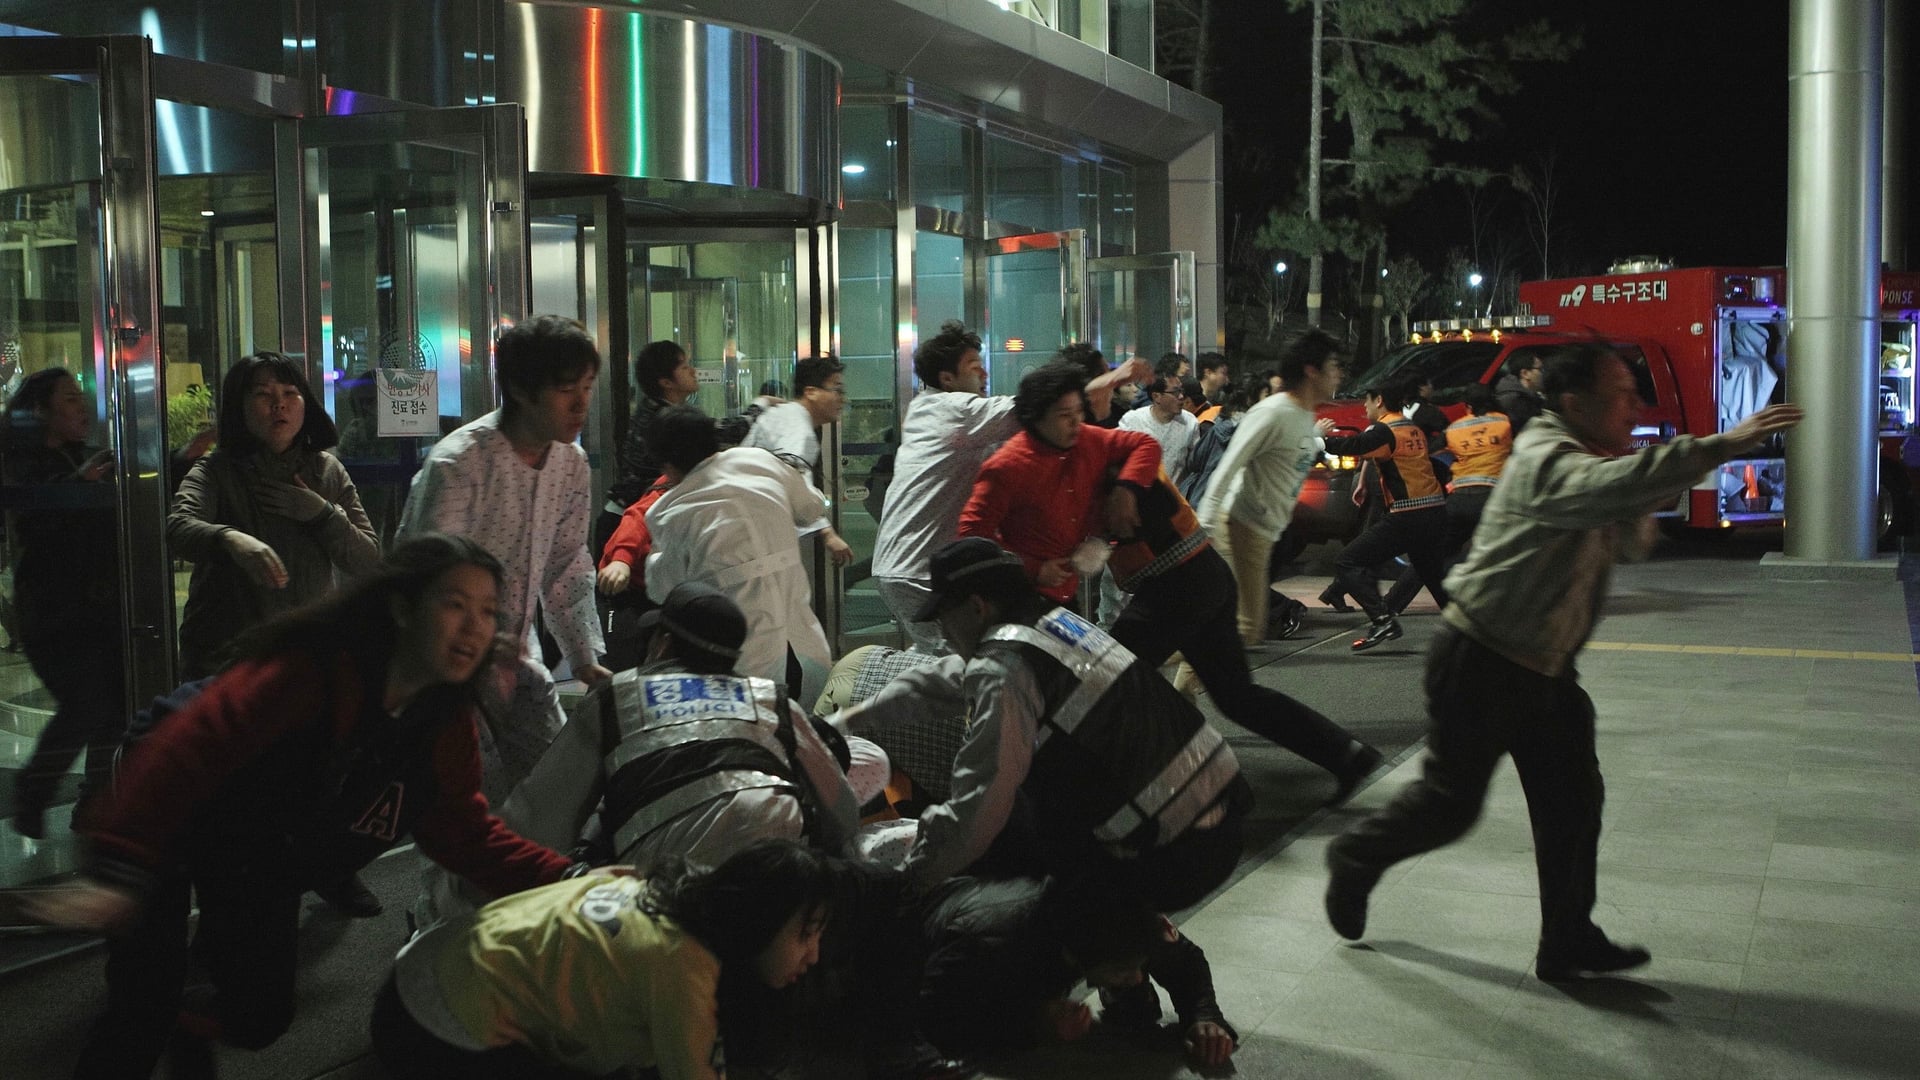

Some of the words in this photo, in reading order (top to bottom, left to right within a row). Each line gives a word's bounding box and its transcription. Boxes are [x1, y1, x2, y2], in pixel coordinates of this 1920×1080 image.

[1592, 280, 1667, 304] 특수구조대
[1882, 289, 1914, 304] PONSE
[391, 400, 408, 415] 진료
[410, 400, 428, 415] 접수
[1405, 439, 1424, 450] 구조
[351, 782, 404, 840] A
